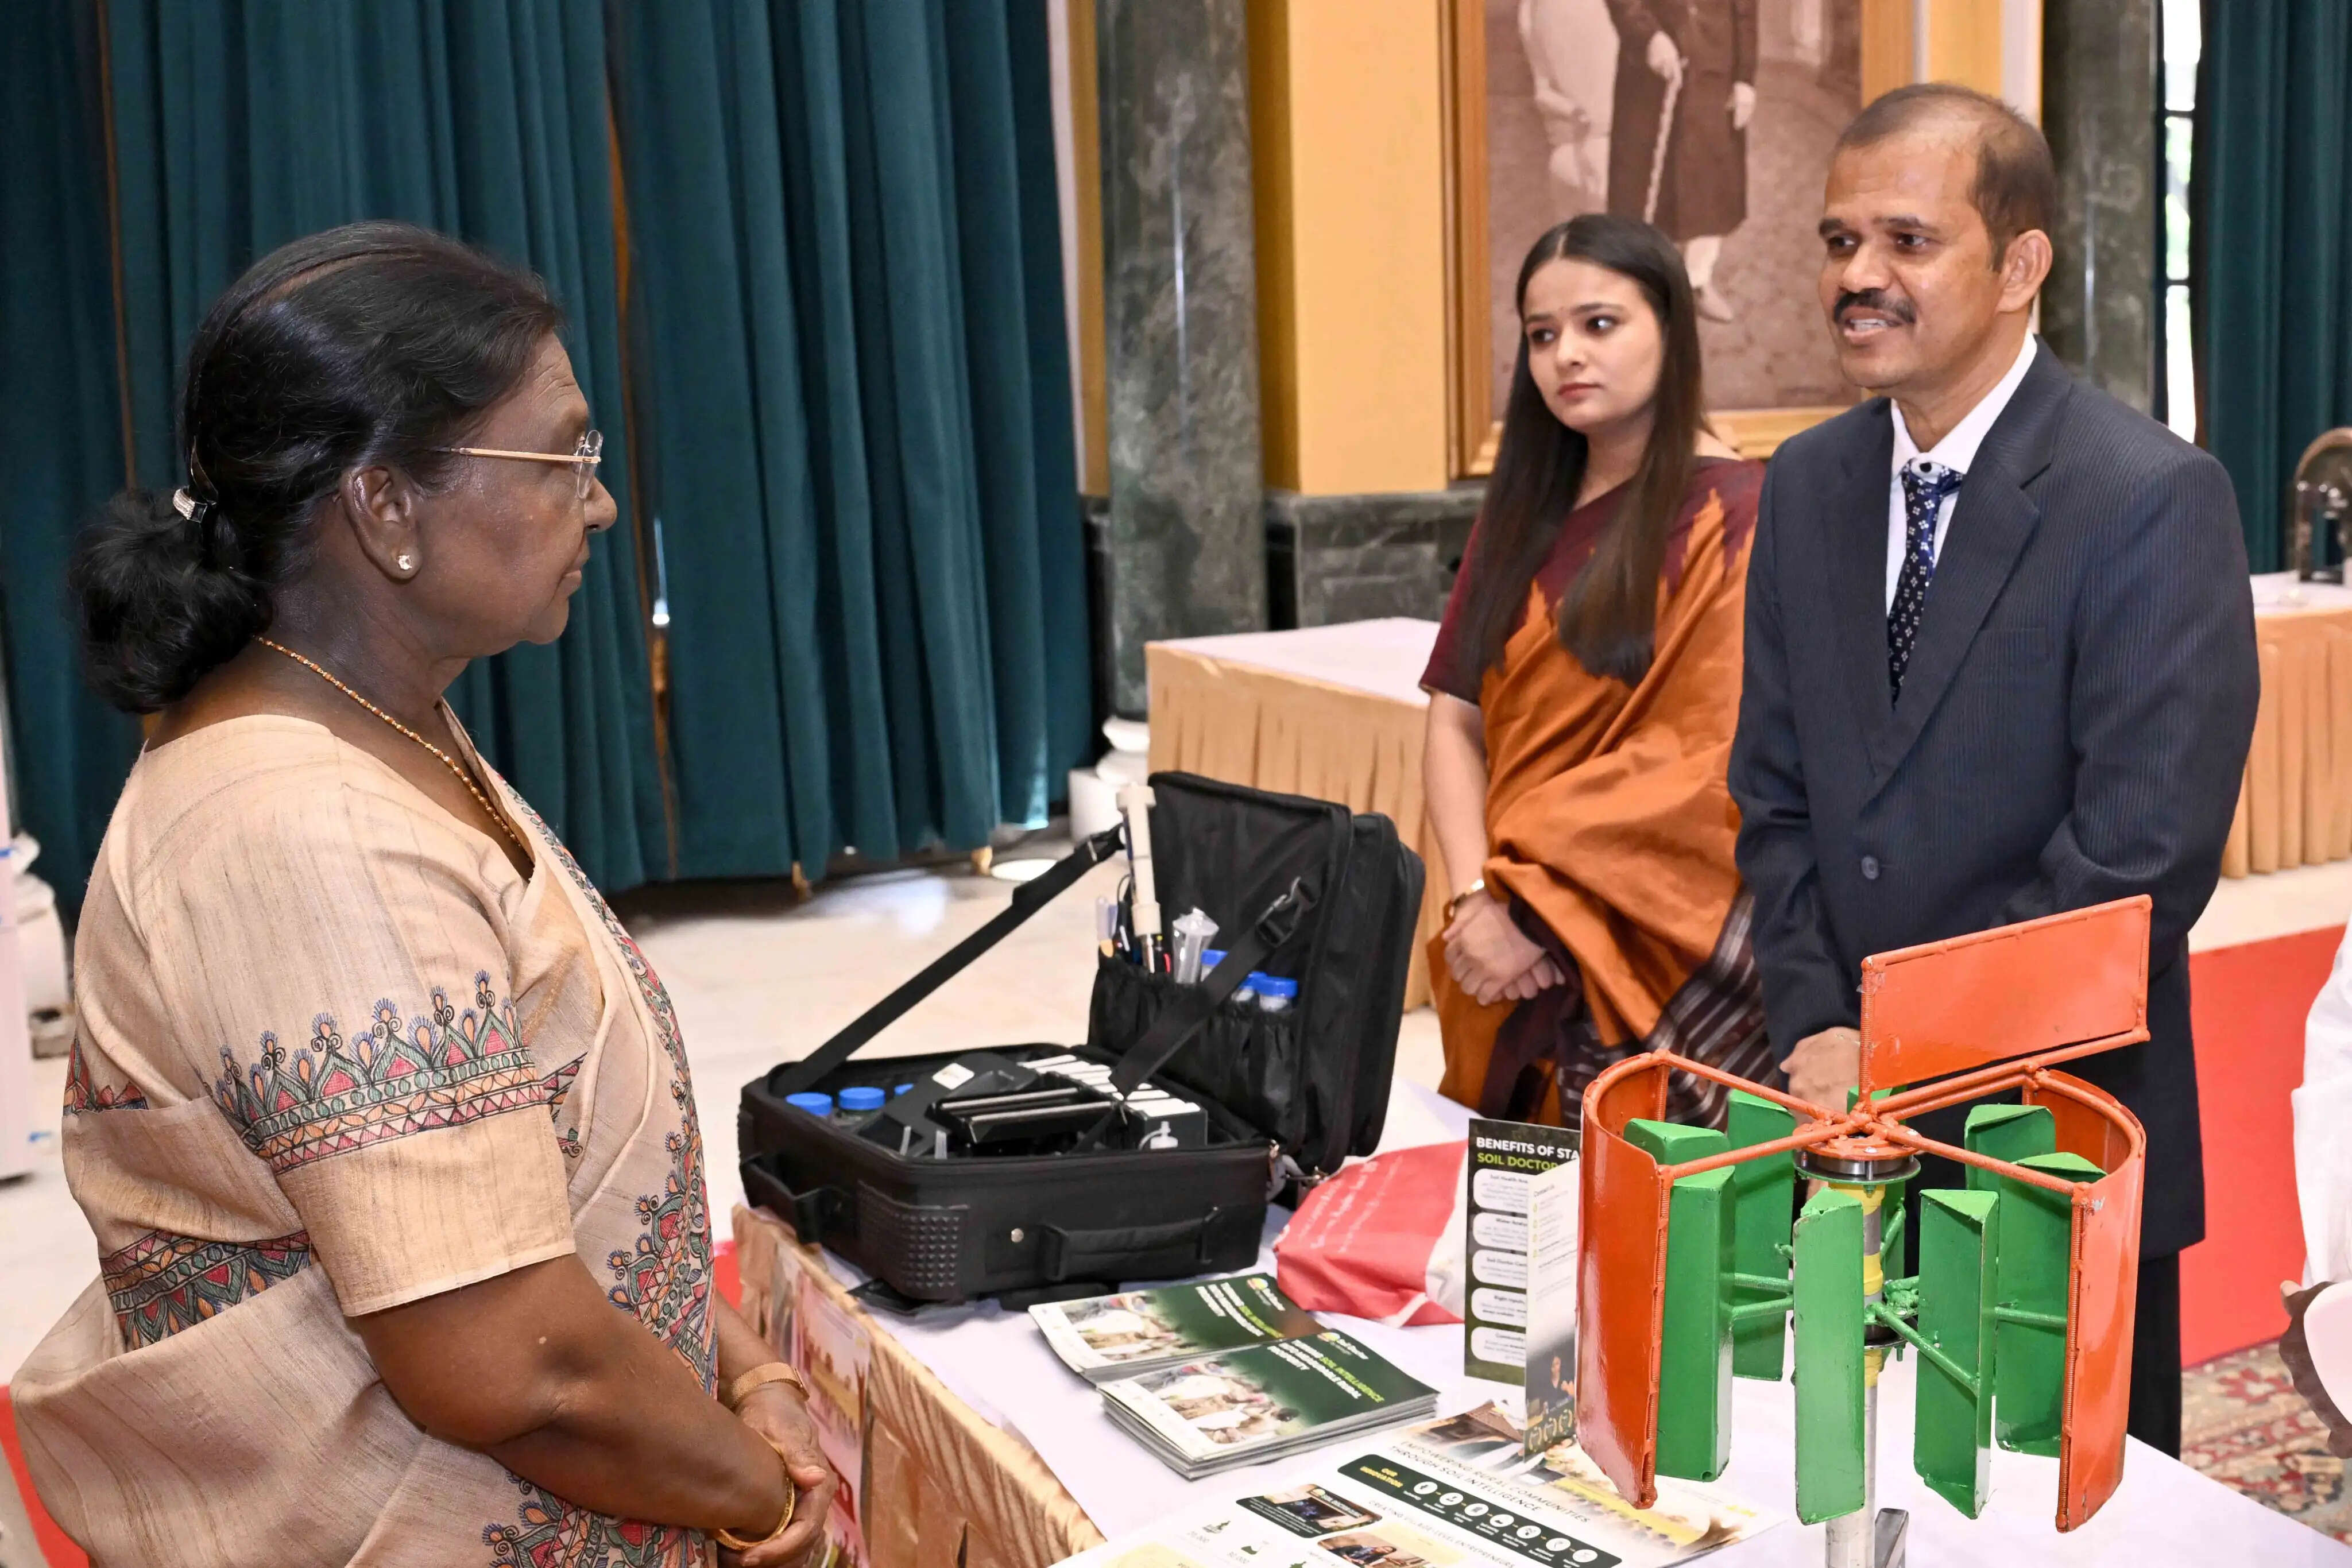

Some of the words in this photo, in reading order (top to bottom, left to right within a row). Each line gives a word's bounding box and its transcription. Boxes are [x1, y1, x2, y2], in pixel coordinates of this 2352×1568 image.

[1476, 1137, 1535, 1155] BENEFITS
[1537, 1145, 1555, 1156] OF
[1477, 1152, 1504, 1165] SOIL
[1439, 1467, 1464, 1479] SOIL
[1464, 1477, 1542, 1512] INTELLIGENCE
[1509, 1486, 1591, 1523] COMMUNITIES
